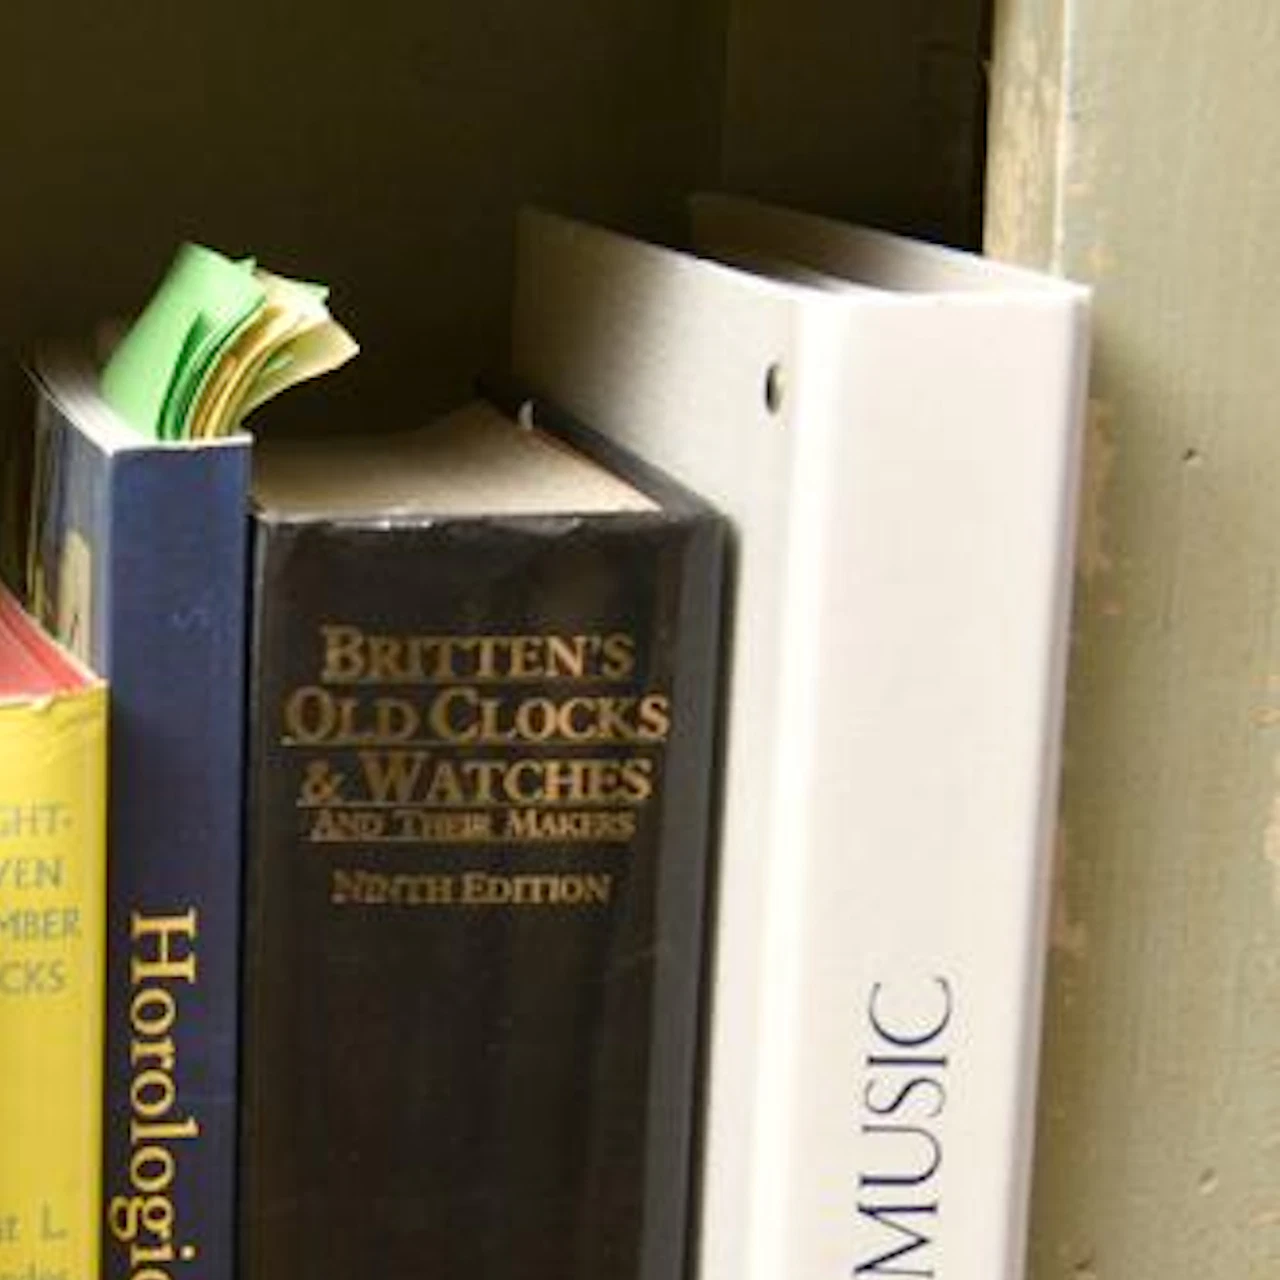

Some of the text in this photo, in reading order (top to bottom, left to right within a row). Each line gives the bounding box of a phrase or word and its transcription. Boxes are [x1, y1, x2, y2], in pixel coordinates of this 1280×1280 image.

[320, 625, 636, 684] BRITTEN'S
[285, 685, 672, 744] OLD CLOCKS
[301, 750, 655, 803] & WATCHES
[313, 808, 637, 841] AND THEIR MAKERS
[332, 870, 616, 905] NINTH EDITION
[851, 974, 954, 1279] MUSIC
[40, 1203, 70, 1242] L.
